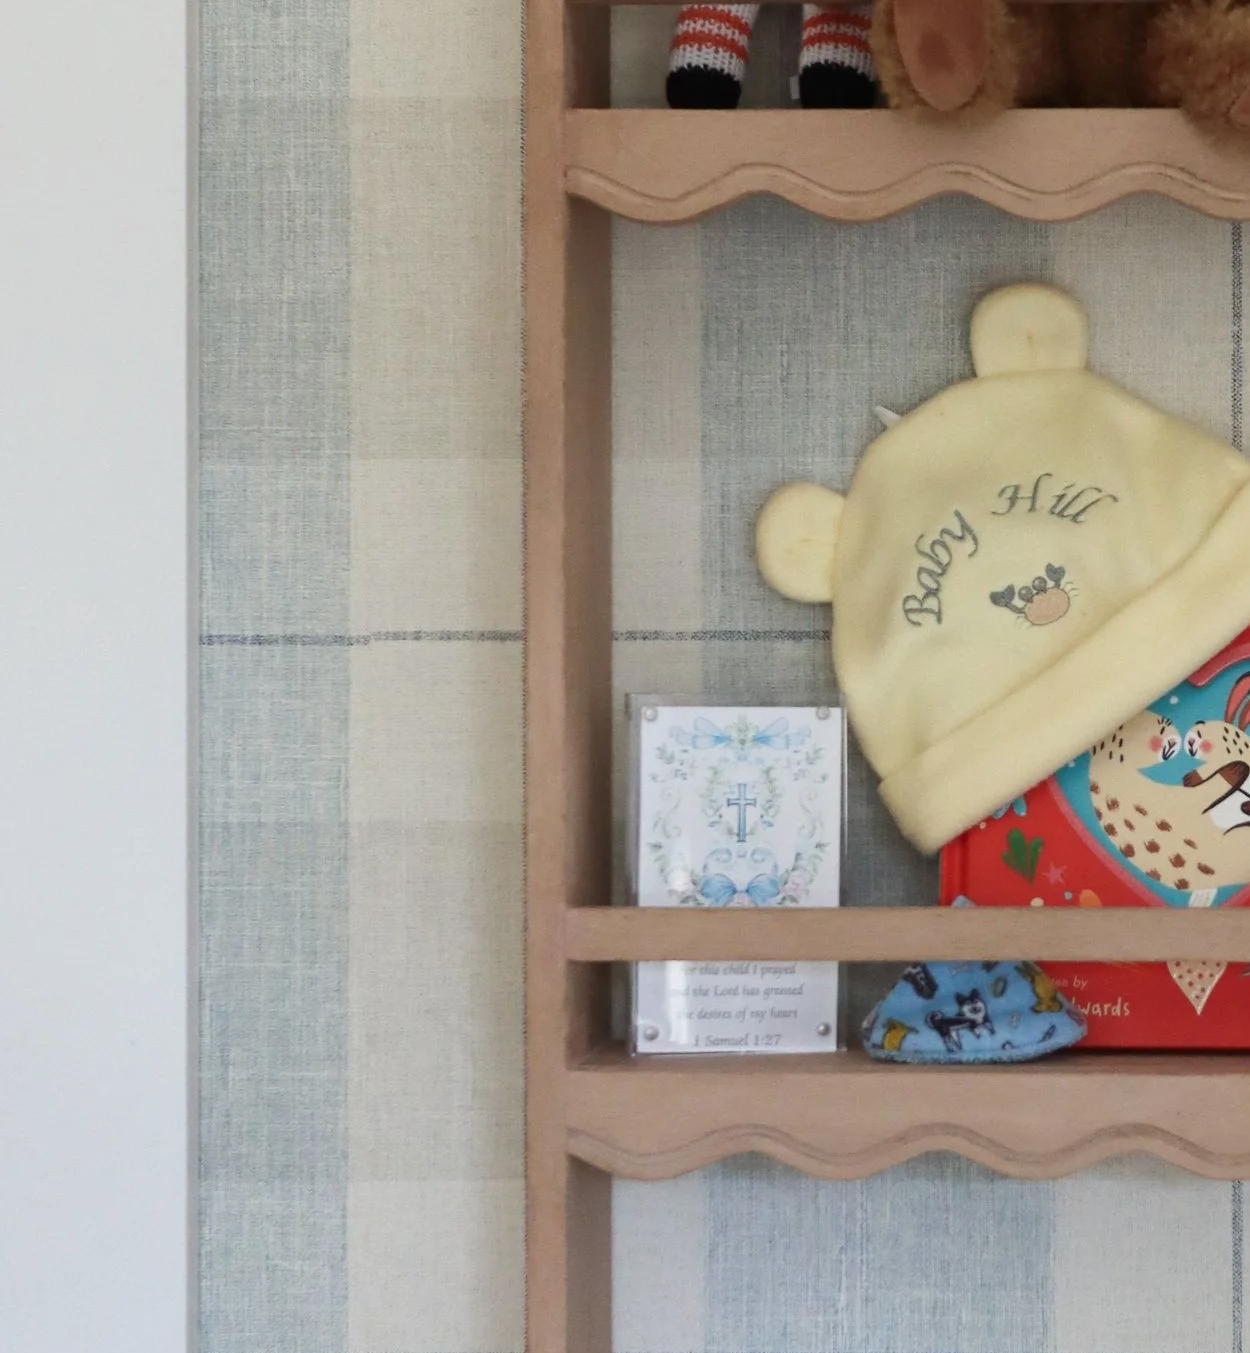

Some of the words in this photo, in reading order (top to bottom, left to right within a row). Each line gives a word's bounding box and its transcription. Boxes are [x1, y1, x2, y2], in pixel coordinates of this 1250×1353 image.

[902, 509, 979, 627] Baby
[991, 472, 1119, 524] Hill
[698, 963, 719, 975] this
[722, 962, 750, 975] child
[761, 962, 797, 979] prayed
[1072, 975, 1088, 990] by
[713, 984, 740, 996] Lord
[742, 984, 760, 996] has
[763, 984, 806, 999] granted
[697, 1007, 732, 1019] desires
[734, 1006, 748, 1022] of
[749, 1010, 766, 1022] my
[770, 1006, 798, 1019] heart
[1072, 996, 1131, 1017] wards
[705, 1034, 750, 1047] Samuel
